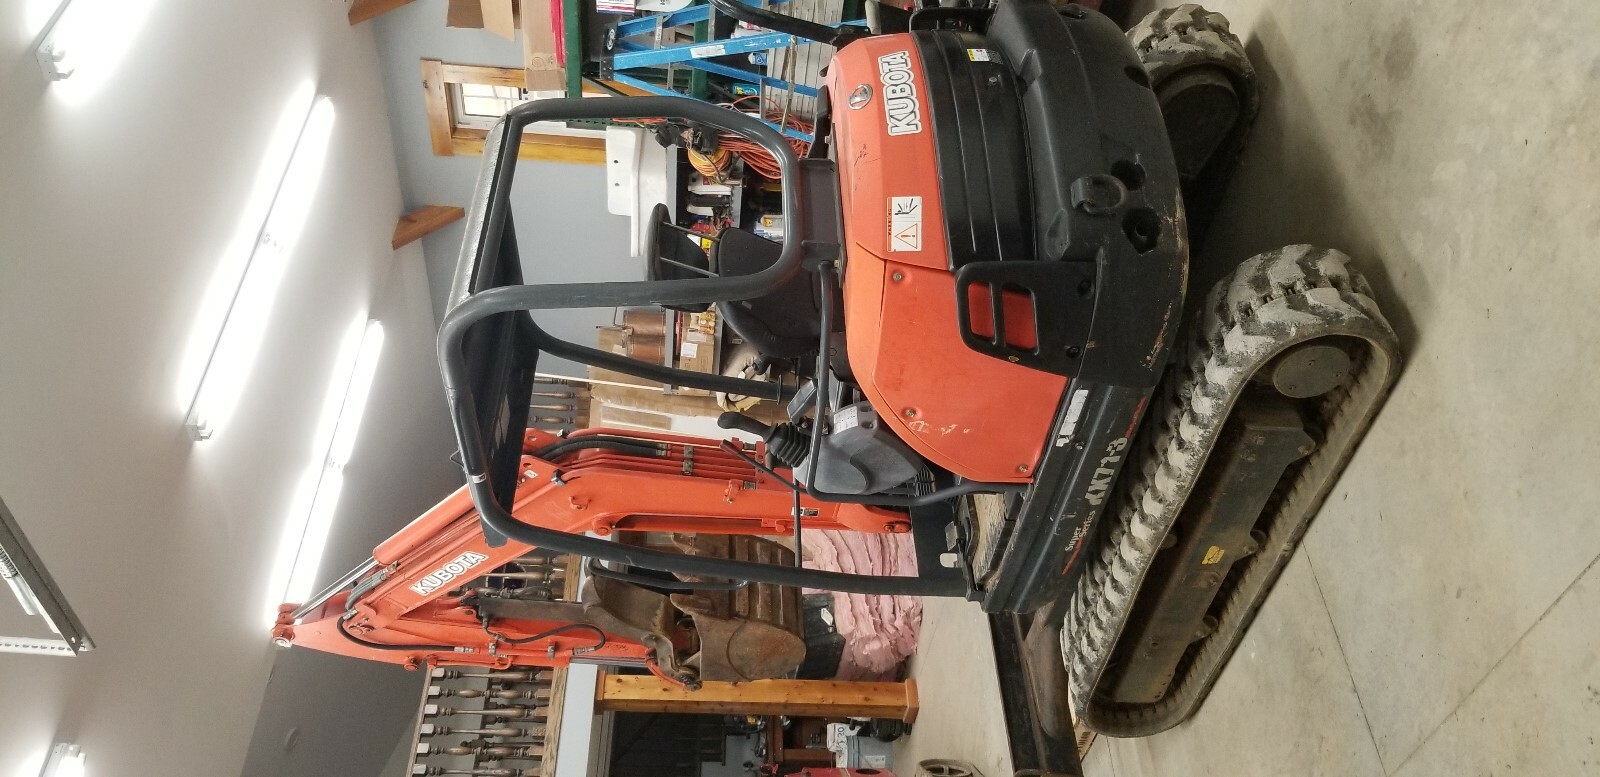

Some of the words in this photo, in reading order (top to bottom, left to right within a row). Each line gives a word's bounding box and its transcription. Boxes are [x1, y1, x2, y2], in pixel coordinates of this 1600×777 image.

[879, 52, 920, 134] KUBOTA
[1084, 437, 1128, 505] KX71-3
[1064, 526, 1082, 551] Super
[1078, 510, 1096, 537] Series
[409, 550, 488, 596] KUBOTA
